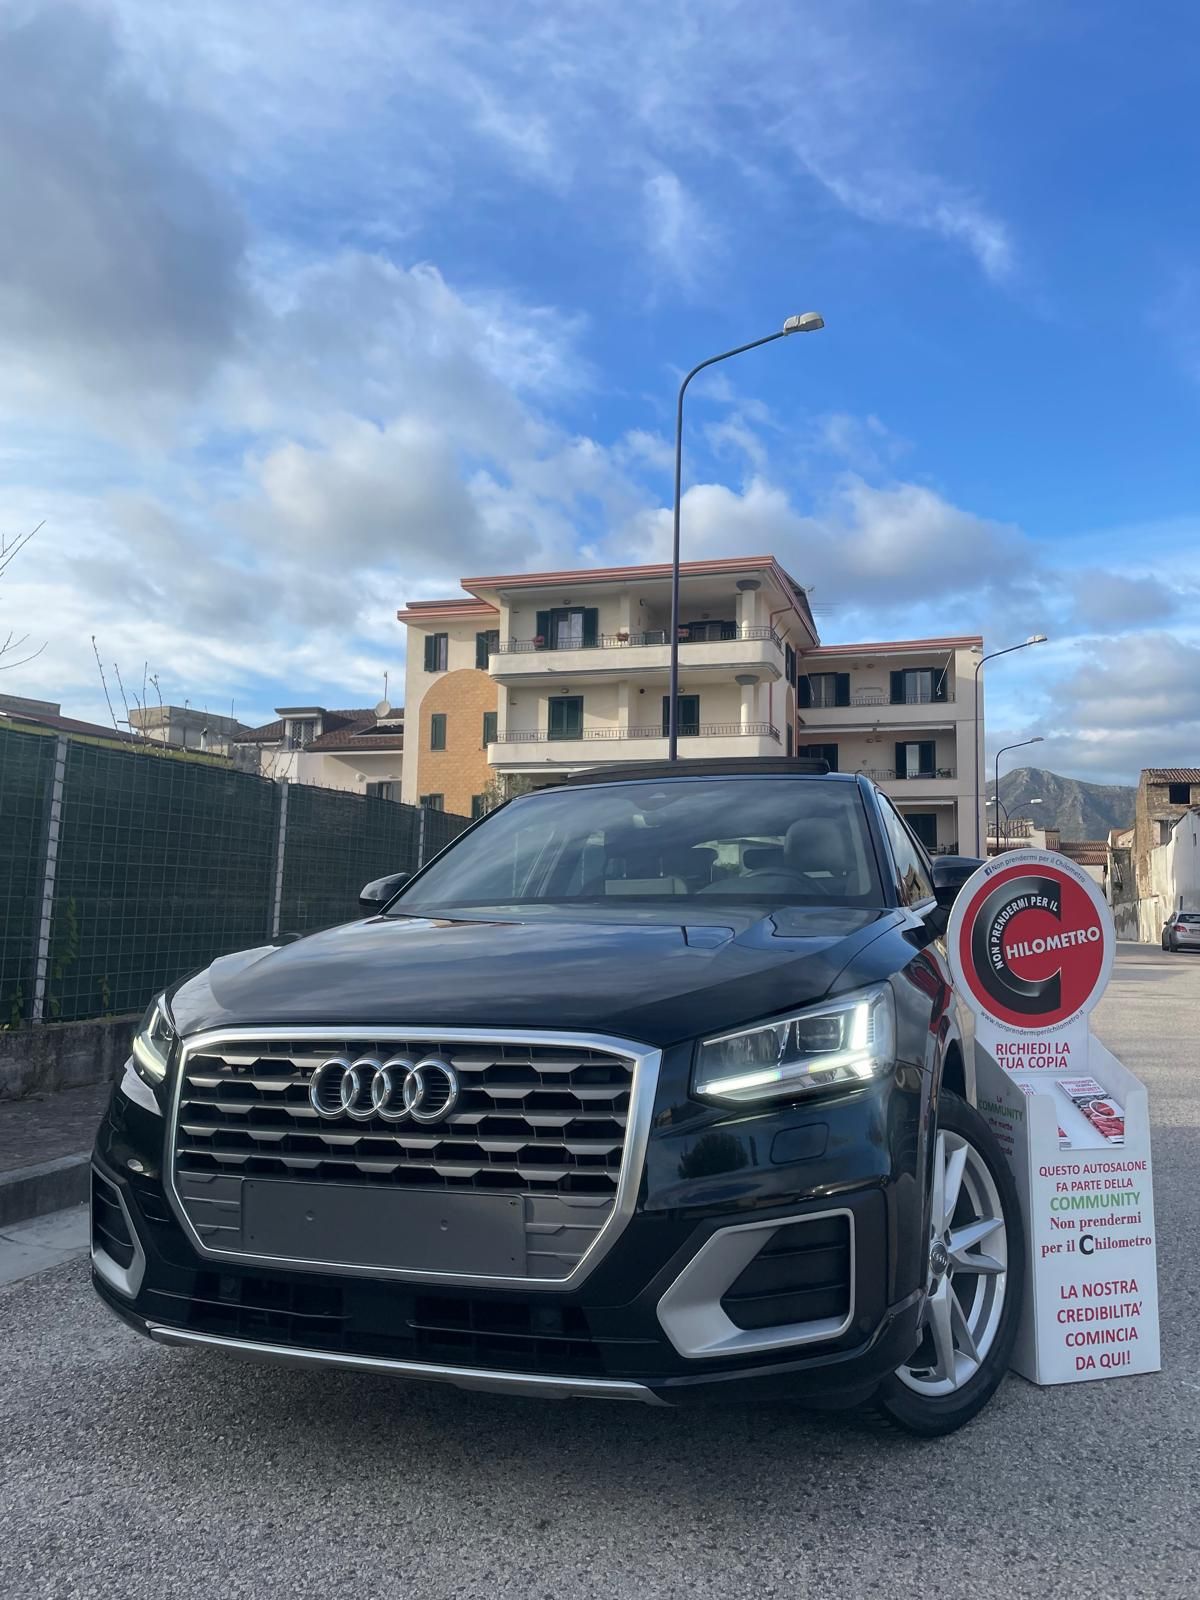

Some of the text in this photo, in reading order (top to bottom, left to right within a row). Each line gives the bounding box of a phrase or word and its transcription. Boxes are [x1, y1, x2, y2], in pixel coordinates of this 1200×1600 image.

[991, 860, 1005, 871] Non
[1005, 855, 1038, 865] prendermi
[1038, 855, 1049, 863] per
[1055, 859, 1086, 883] Chilometro
[991, 896, 1059, 970] NON PRENDERMI PER IL
[996, 1042, 1070, 1056] RICHIEDI LA
[998, 1056, 1068, 1069] TUA COPIA
[977, 1100, 1023, 1120] COMMUNITY
[1039, 1160, 1147, 1177] QUESTO AUTOSALONE
[1056, 1178, 1133, 1192] FA PARTE DELLA
[1050, 1192, 1141, 1211] COMMUNITY
[1050, 1211, 1142, 1232] Non prendermi
[1041, 1234, 1152, 1258] per il Chilometro
[1060, 1279, 1138, 1299] LA NOSTRA
[1065, 1327, 1138, 1347] COMINCIA
[1075, 1350, 1131, 1371] DA QUI!
